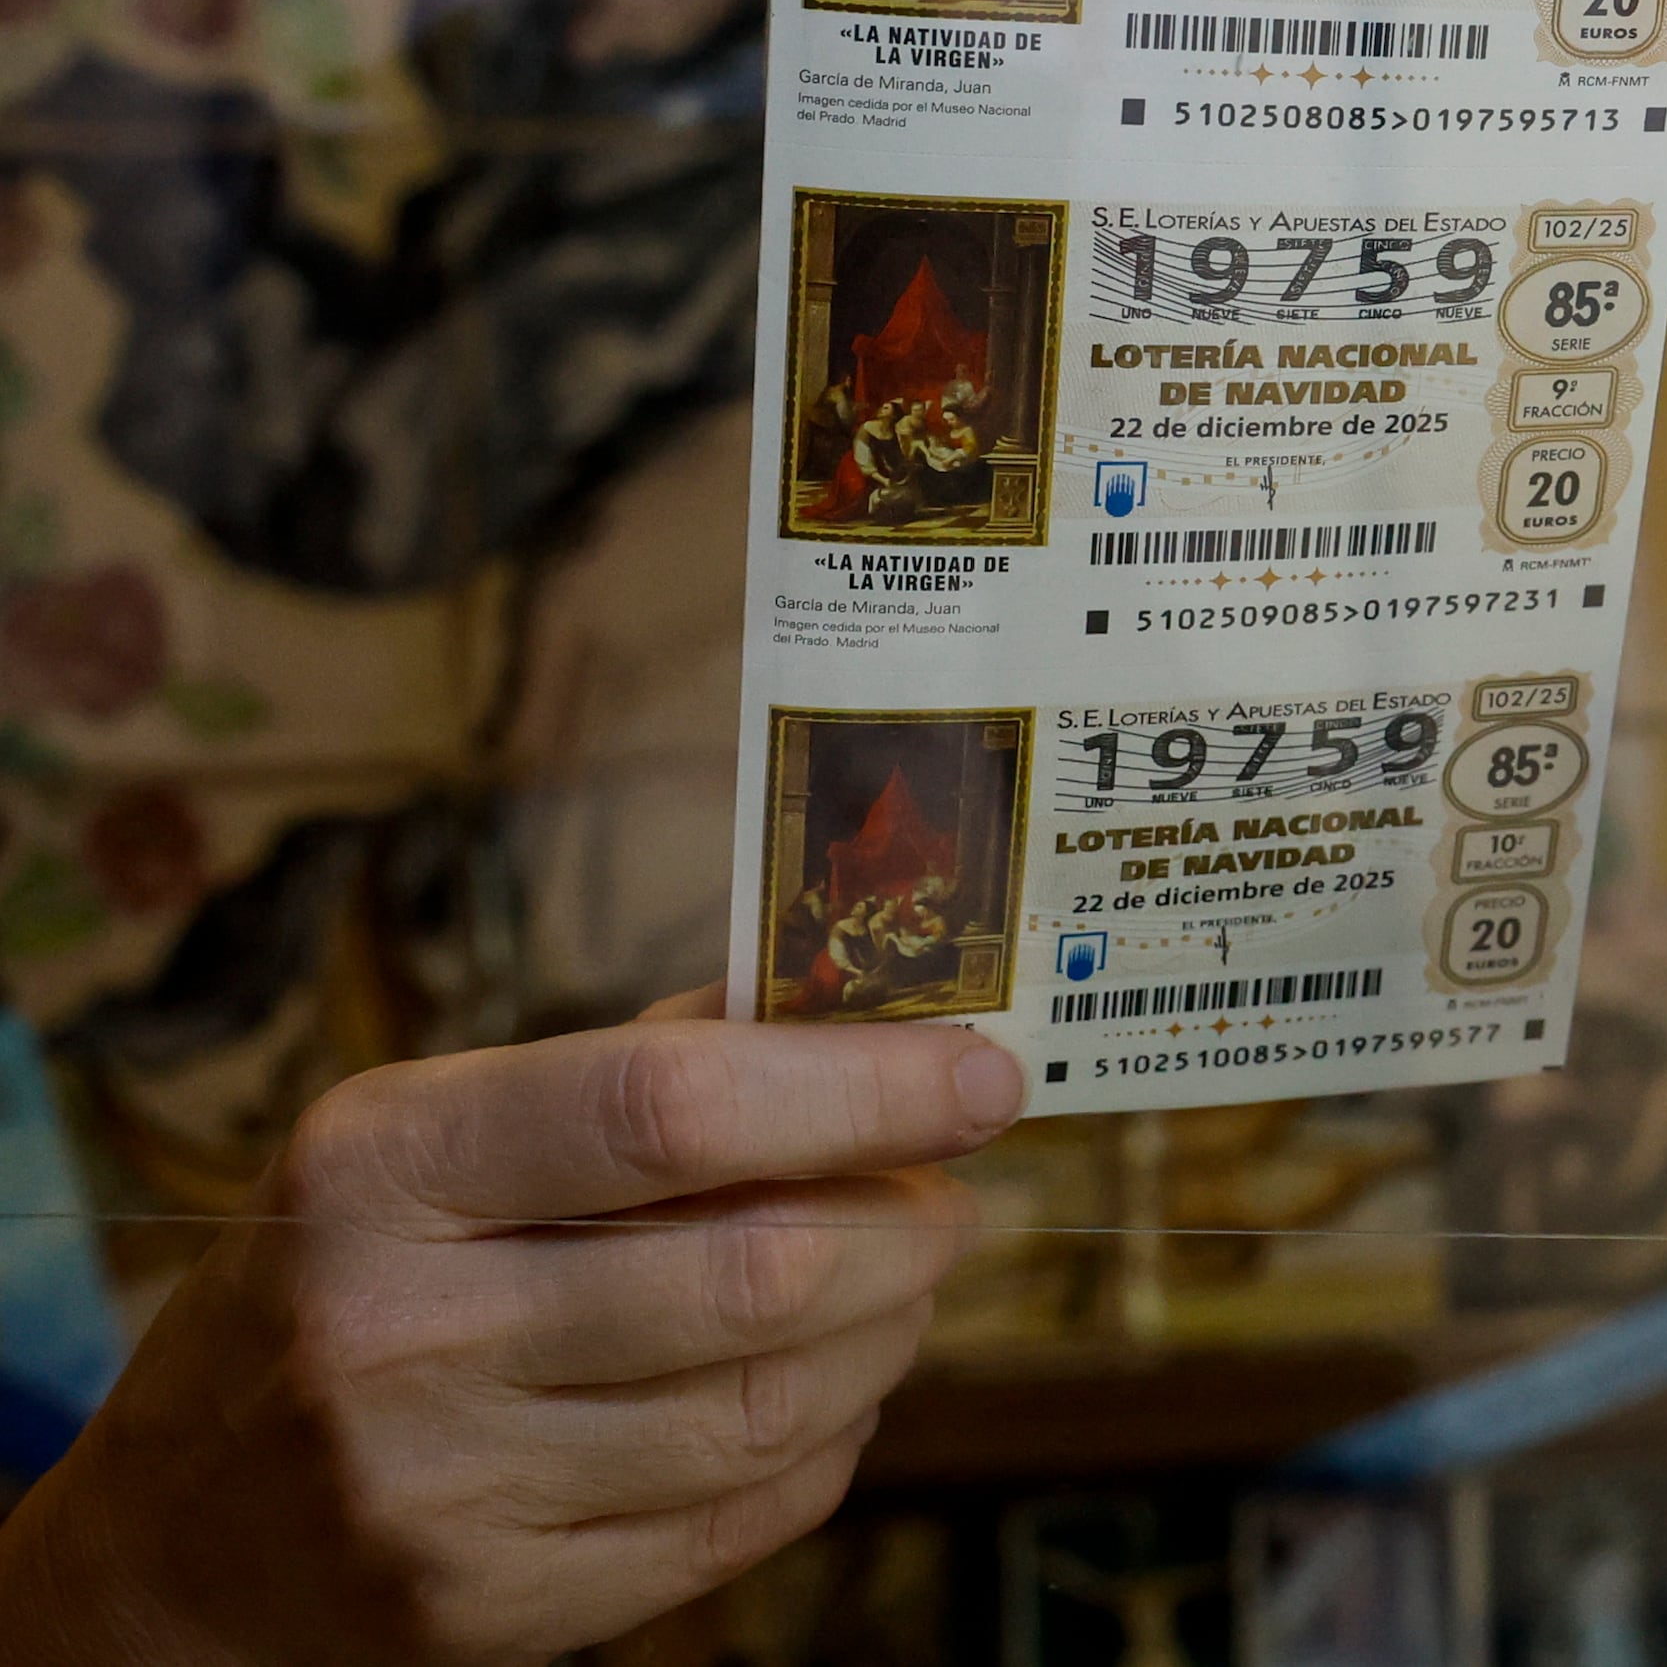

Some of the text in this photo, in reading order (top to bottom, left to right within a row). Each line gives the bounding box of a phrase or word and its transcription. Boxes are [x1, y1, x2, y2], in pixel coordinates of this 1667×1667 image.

[1174, 99, 1619, 134] 5102508085>0197595713
[1117, 234, 1492, 305] 19759
[1090, 338, 1480, 370] LOTERÍA NACIONAL
[1159, 380, 1408, 407] DE NAVIDAD
[1524, 470, 1581, 508] 20
[1135, 589, 1561, 633] 5102509085>0197597231
[1083, 713, 1439, 791] 19759
[1055, 805, 1426, 855] LOTERÍA NACIONAL
[1119, 843, 1357, 883] DE NAVIDAD
[1468, 916, 1522, 953] 20
[1093, 1025, 1501, 1078] 5102510085>0197599577
